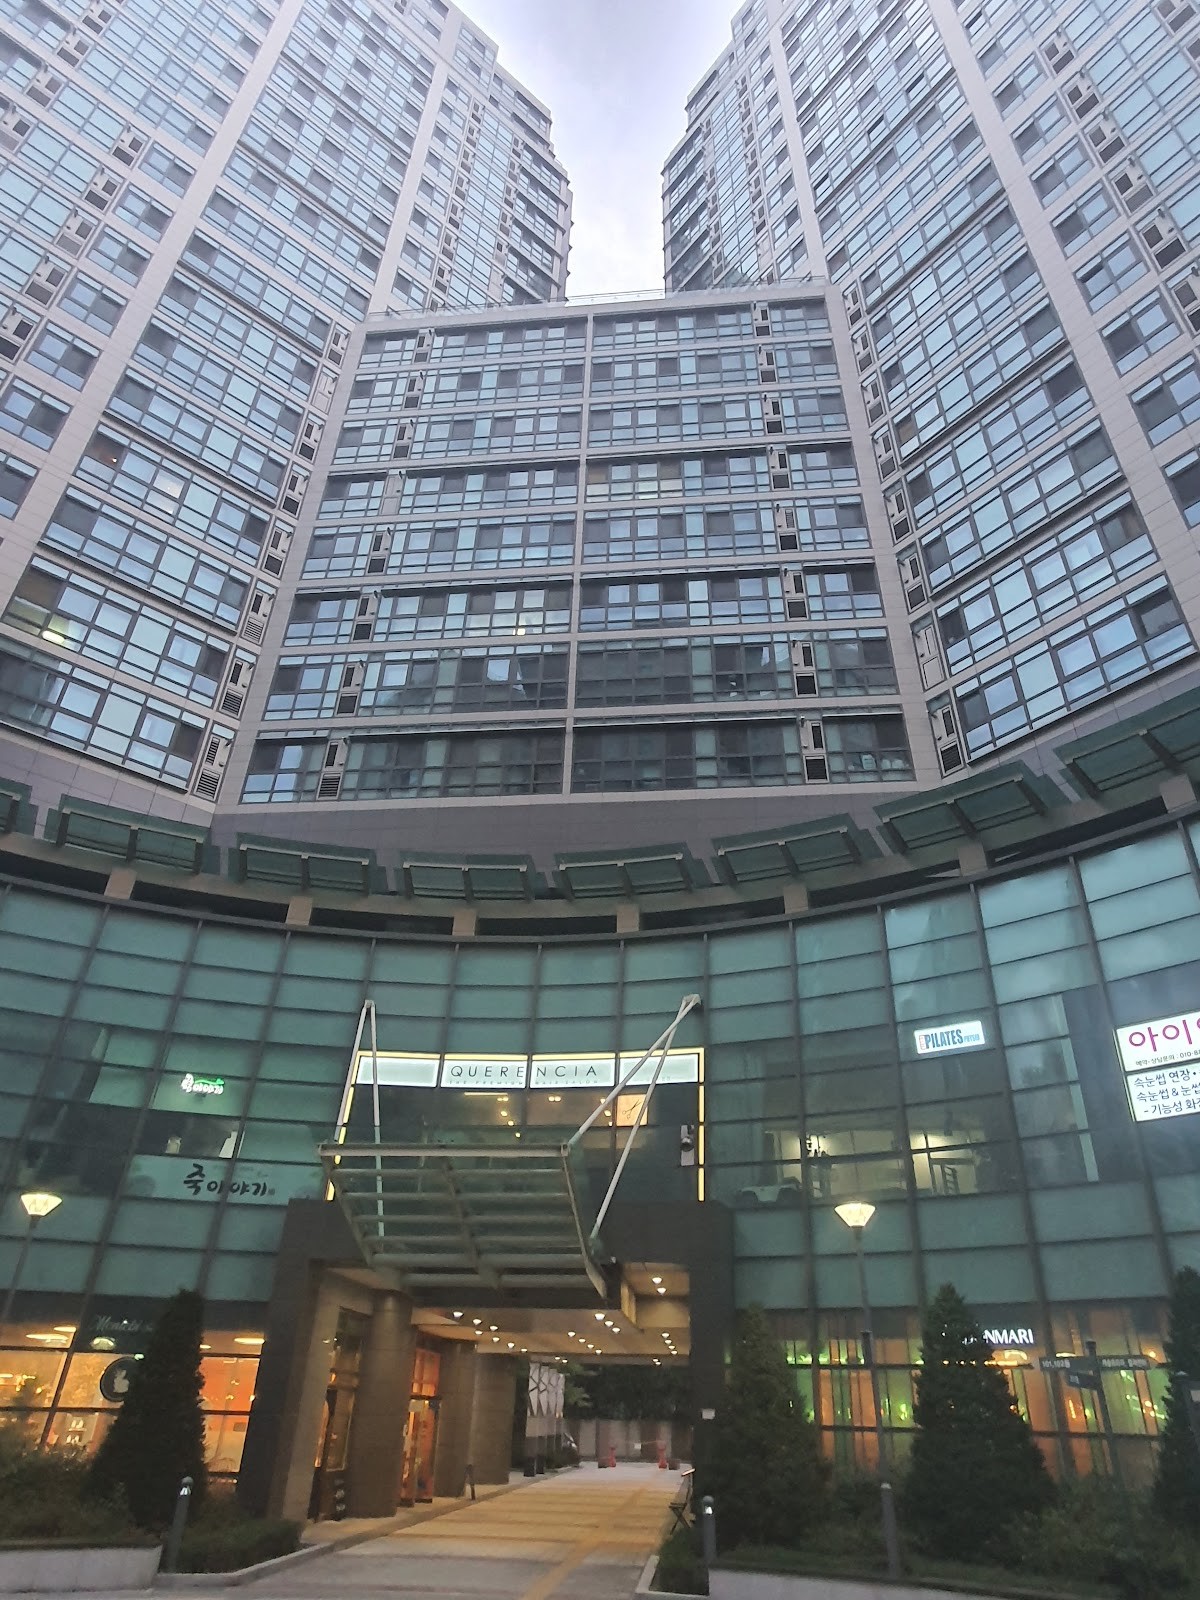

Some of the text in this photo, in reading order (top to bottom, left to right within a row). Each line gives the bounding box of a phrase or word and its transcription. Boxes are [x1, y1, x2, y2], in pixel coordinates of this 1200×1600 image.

[925, 1029, 964, 1049] PILATES
[1128, 1018, 1200, 1052] 아이
[450, 1065, 597, 1078] QUERENCIA
[1134, 1068, 1190, 1088] 속눈썹 연장
[1136, 1087, 1170, 1102] 속눈썹
